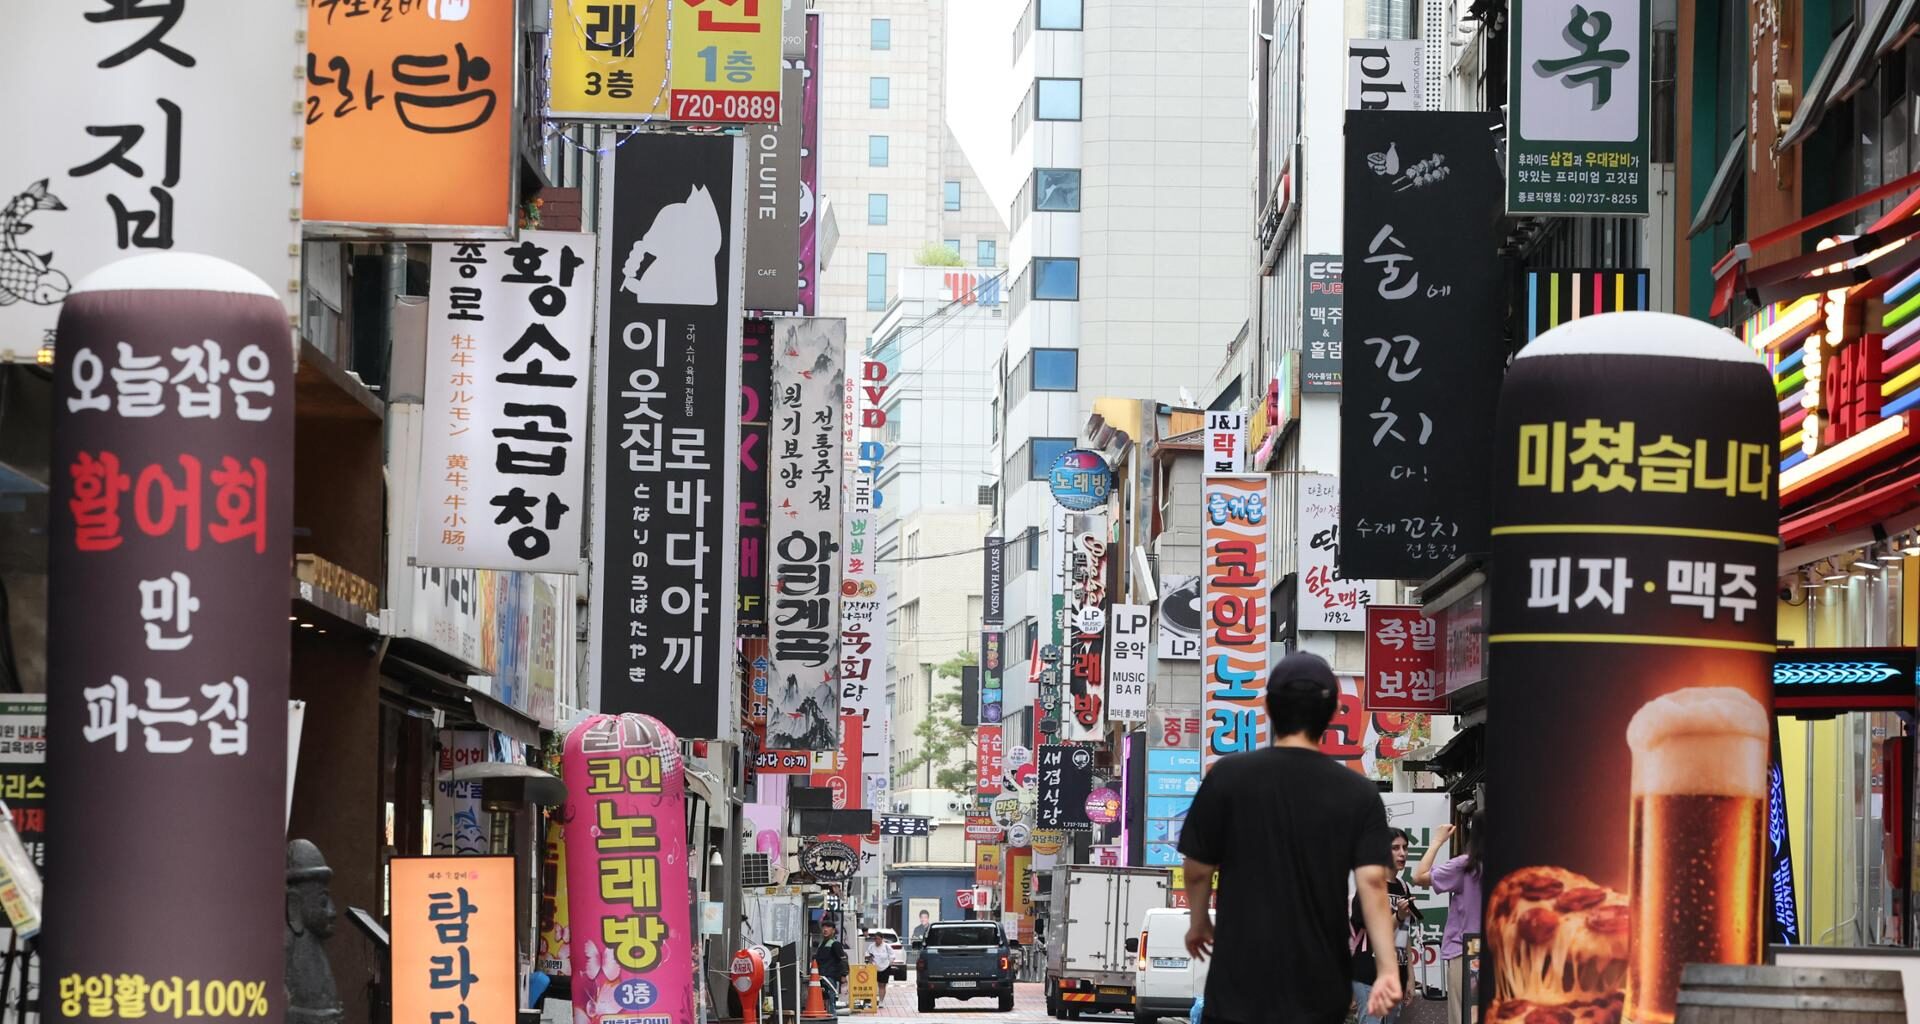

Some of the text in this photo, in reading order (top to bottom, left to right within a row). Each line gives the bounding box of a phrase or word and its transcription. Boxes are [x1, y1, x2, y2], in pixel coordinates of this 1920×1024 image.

[697, 46, 755, 83] 1층
[584, 70, 633, 99] 3층
[676, 95, 776, 119] 720-0889
[1518, 154, 1548, 167] 후라이드
[1585, 153, 1640, 168] 우대갈비가
[1518, 171, 1639, 185] 맛있는 프리미엄 고깃집
[1518, 192, 1561, 204] 종로직영점
[1569, 193, 1639, 205] 02)737-8255
[448, 243, 487, 322] 종로
[757, 269, 778, 277] CAFE
[1310, 307, 1342, 325] 맥주
[1310, 341, 1342, 360] 홀덤
[67, 339, 276, 422] 오늘잡은
[620, 319, 667, 473] 이웃집
[862, 361, 889, 428] DVD
[489, 241, 584, 561] 황소곱창
[780, 383, 804, 489] 원기보양
[1208, 415, 1241, 430] J&J
[809, 406, 834, 511] 전통주점
[1065, 456, 1079, 467] 24
[1517, 418, 1772, 501] 미쳤습니다
[1054, 472, 1106, 497] 노래방
[69, 451, 268, 554] 활어회
[1208, 492, 1264, 525] 즐거운
[1356, 518, 1395, 539] 수제
[660, 427, 712, 685] 로바다야끼
[629, 484, 651, 683] となりのろばたやき
[991, 548, 1001, 616] STAY HAUSDA
[1527, 557, 1633, 615] 피자
[1667, 560, 1758, 622] 맥주
[139, 571, 200, 650] 만
[1084, 611, 1100, 621] LP
[1116, 614, 1147, 634] LP
[1324, 613, 1351, 623] 1982
[1114, 642, 1147, 660] 음악
[1113, 672, 1145, 683] MUSIC
[1116, 685, 1142, 695] BAR
[82, 675, 249, 756] 파는집
[586, 755, 662, 794] 코인
[598, 800, 668, 970] 노래방
[1780, 857, 1797, 936] DRAGON
[59, 974, 269, 1019] 당일활어100%
[622, 982, 651, 1005] 3층
